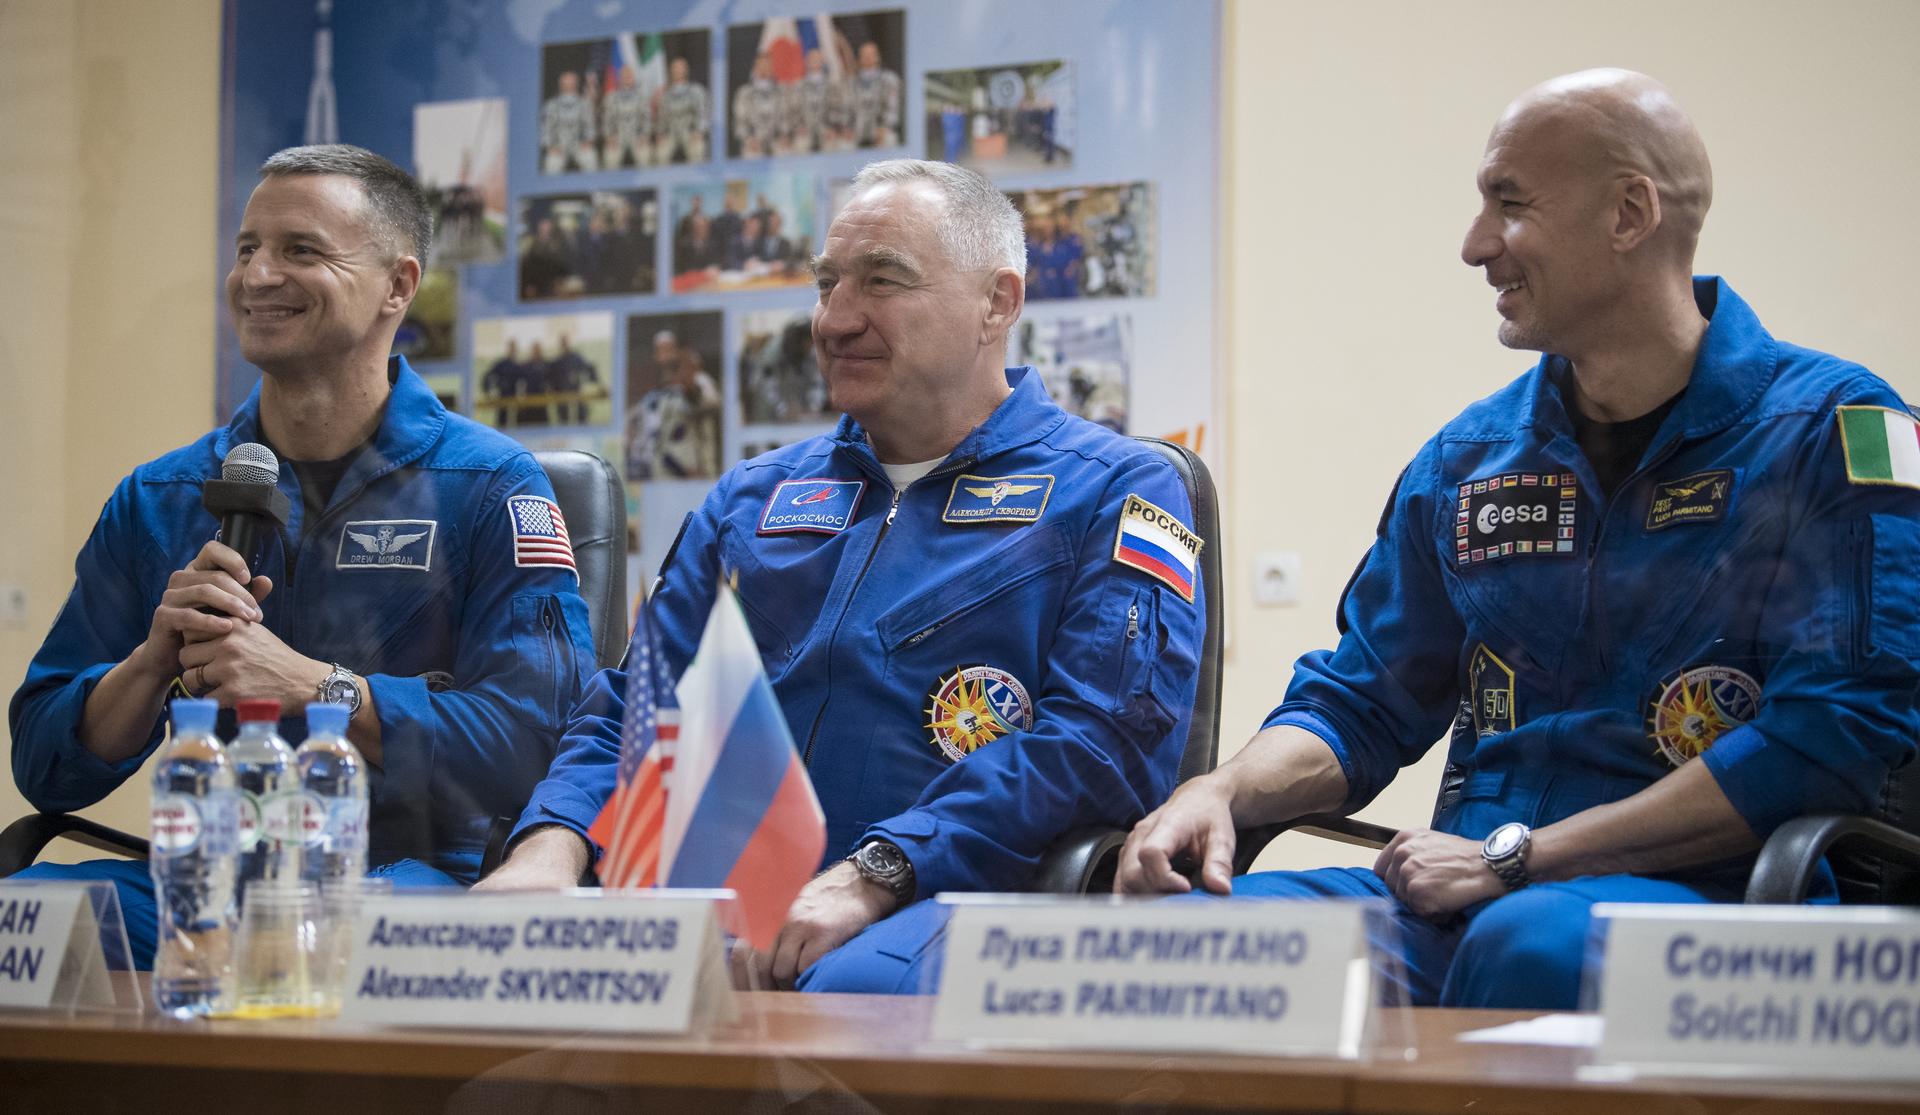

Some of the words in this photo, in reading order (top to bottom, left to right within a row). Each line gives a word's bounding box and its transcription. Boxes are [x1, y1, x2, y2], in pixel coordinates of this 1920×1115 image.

[768, 514, 844, 525] РОСКОСМОС
[949, 508, 994, 517] АЛЕКСАНДР
[995, 507, 1037, 516] СКВОРЦОВ
[1128, 500, 1197, 554] РОССИЯ
[350, 555, 374, 564] DREW
[378, 555, 413, 566] MORGAN
[963, 670, 1002, 682] PARMITANO
[986, 681, 1023, 723] LXI
[1713, 680, 1754, 720] LXI
[0, 899, 42, 934] АН
[368, 915, 515, 956] Александр
[522, 916, 680, 957] СКВОРЦОВ
[979, 926, 1065, 969] Лука
[1074, 927, 1309, 967] ПАРМИТАНО
[1665, 932, 1818, 980] Соичи
[357, 965, 491, 1000] Alexander
[494, 968, 671, 1004] SKVORTSOV
[982, 981, 1064, 1017] Luca
[1073, 981, 1290, 1022] PARMITANO
[1667, 992, 1801, 1041] Soichi
[1812, 998, 1920, 1047] NOG
